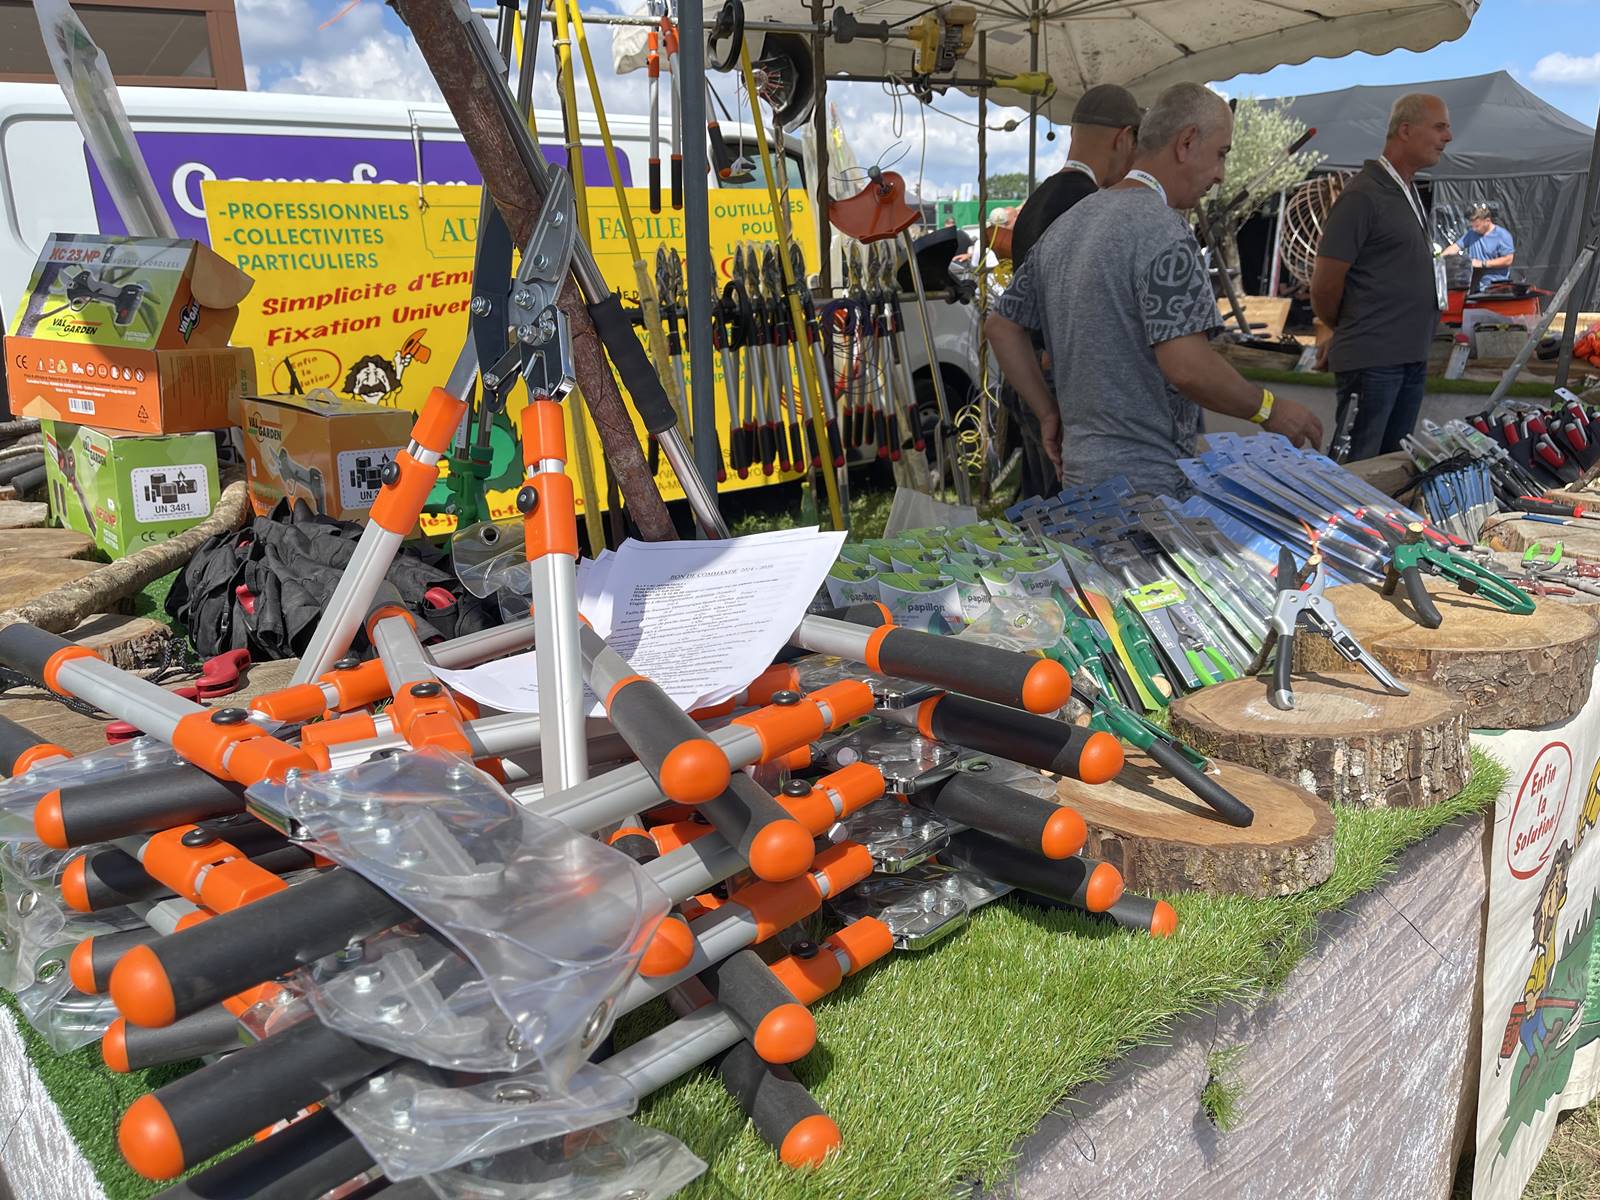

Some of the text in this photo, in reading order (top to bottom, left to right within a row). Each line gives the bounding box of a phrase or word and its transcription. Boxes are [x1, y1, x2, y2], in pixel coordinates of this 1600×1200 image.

[715, 201, 804, 218] OUTILLAES
[742, 222, 773, 235] POU
[237, 253, 380, 271] PARTICULIERS
[262, 283, 397, 316] Simplicite
[52, 318, 66, 327] VAL
[64, 324, 98, 335] GARDEN
[267, 316, 381, 346] Fixation
[249, 416, 259, 429] VAL
[258, 426, 283, 441] GARDEN
[360, 490, 372, 500] UN
[155, 503, 191, 514] UN 3481
[907, 601, 946, 613] papillon
[1531, 763, 1557, 797] Enfin
[1537, 795, 1547, 817] la
